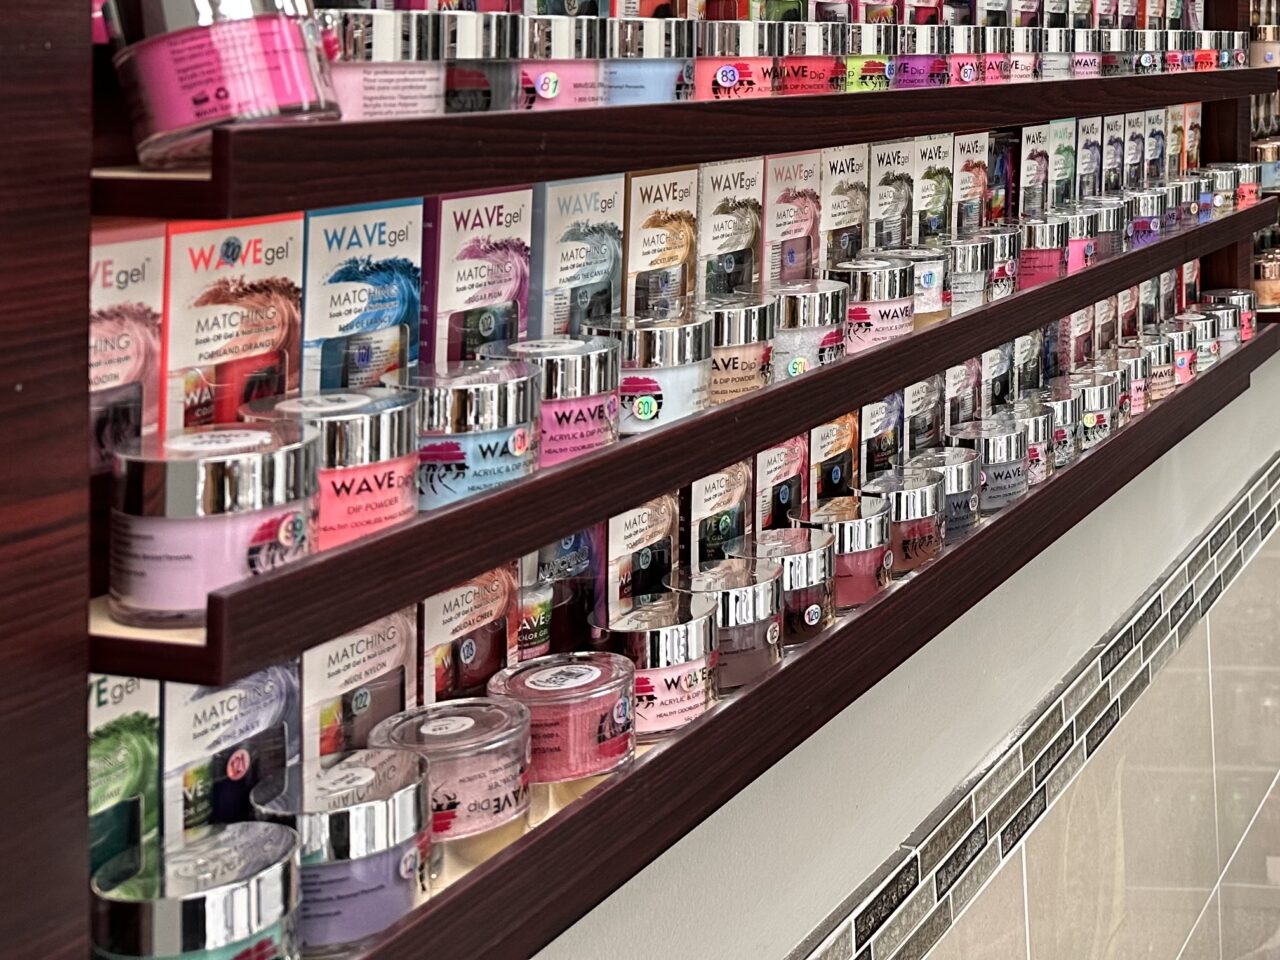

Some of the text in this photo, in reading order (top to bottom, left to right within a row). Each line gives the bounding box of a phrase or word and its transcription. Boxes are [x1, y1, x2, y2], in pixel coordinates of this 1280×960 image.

[1075, 58, 1097, 67] WAVE
[721, 70, 735, 82] 83
[810, 70, 824, 80] Dip
[963, 68, 972, 79] 87
[540, 77, 558, 93] 81
[800, 83, 824, 91] POWDER
[920, 145, 949, 161] WAVEgel
[959, 141, 985, 155] WAVEgel
[829, 158, 864, 176] WAVEgel
[877, 151, 909, 167] WAVEgel
[774, 163, 815, 183] WAVEgel
[711, 172, 757, 192] WAVEgel
[640, 182, 691, 204] WAVEgel
[557, 191, 615, 216] WAVEgel
[453, 205, 522, 232] WAVEgel
[776, 206, 808, 220] MATCHING
[324, 221, 409, 252] WAVEgel
[643, 232, 684, 248] MATCHING
[560, 244, 607, 262] MATCHING
[456, 262, 512, 283] MATCHING
[923, 273, 934, 284] 107
[330, 285, 397, 308] MATCHING
[196, 306, 277, 333] MATCHING
[879, 307, 909, 320] WAVE
[712, 357, 756, 371] AVE Dip
[720, 377, 730, 385] DIP
[731, 375, 755, 383] POWDER
[555, 405, 604, 425] WAVE
[550, 431, 578, 441] ACRYLIC
[479, 442, 512, 459] WA
[472, 466, 504, 478] ACRYLIC
[994, 467, 1021, 481] WAVE
[332, 471, 395, 497] WAVE
[347, 497, 399, 515] DIP POWDER
[443, 580, 499, 615] MATCHING
[328, 626, 396, 667] MATCHING
[463, 644, 473, 660] 123
[364, 661, 386, 679] NYLON
[664, 667, 706, 690] WE
[684, 672, 699, 688] 124
[193, 681, 275, 727] MATCHING
[354, 692, 367, 711] 122
[660, 696, 685, 706] ACRYLIC
